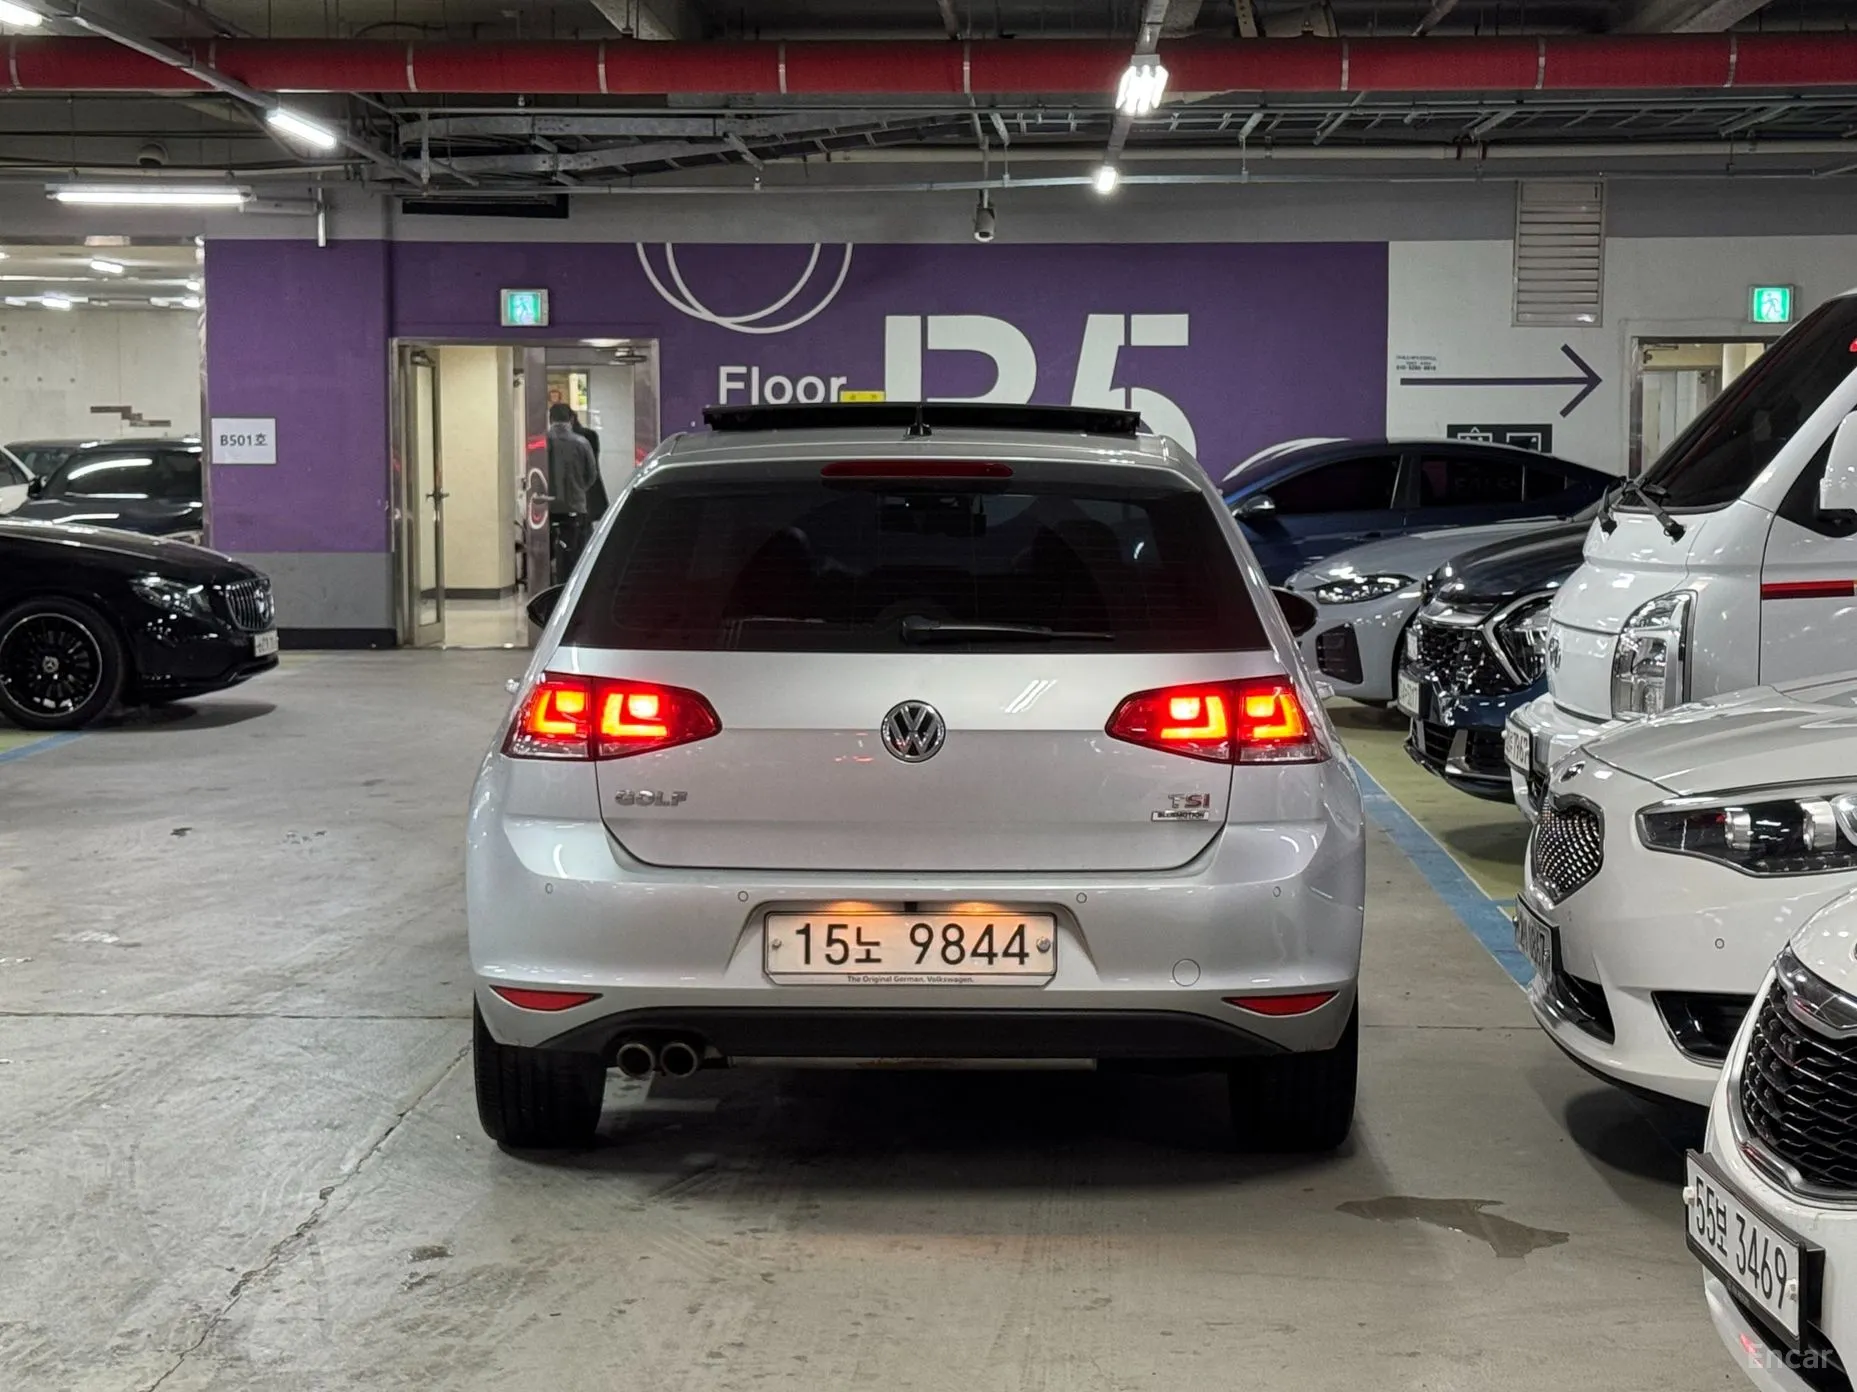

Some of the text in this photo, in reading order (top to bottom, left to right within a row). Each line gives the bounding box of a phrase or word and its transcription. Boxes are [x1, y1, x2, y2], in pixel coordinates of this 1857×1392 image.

[719, 365, 848, 405] Floor
[220, 432, 268, 447] B501호
[615, 789, 688, 806] GOLF
[1167, 793, 1211, 809] TSI
[795, 922, 1030, 966] 15노 9844
[862, 975, 892, 984] Original
[1695, 1175, 1787, 1310] 55보 3469
